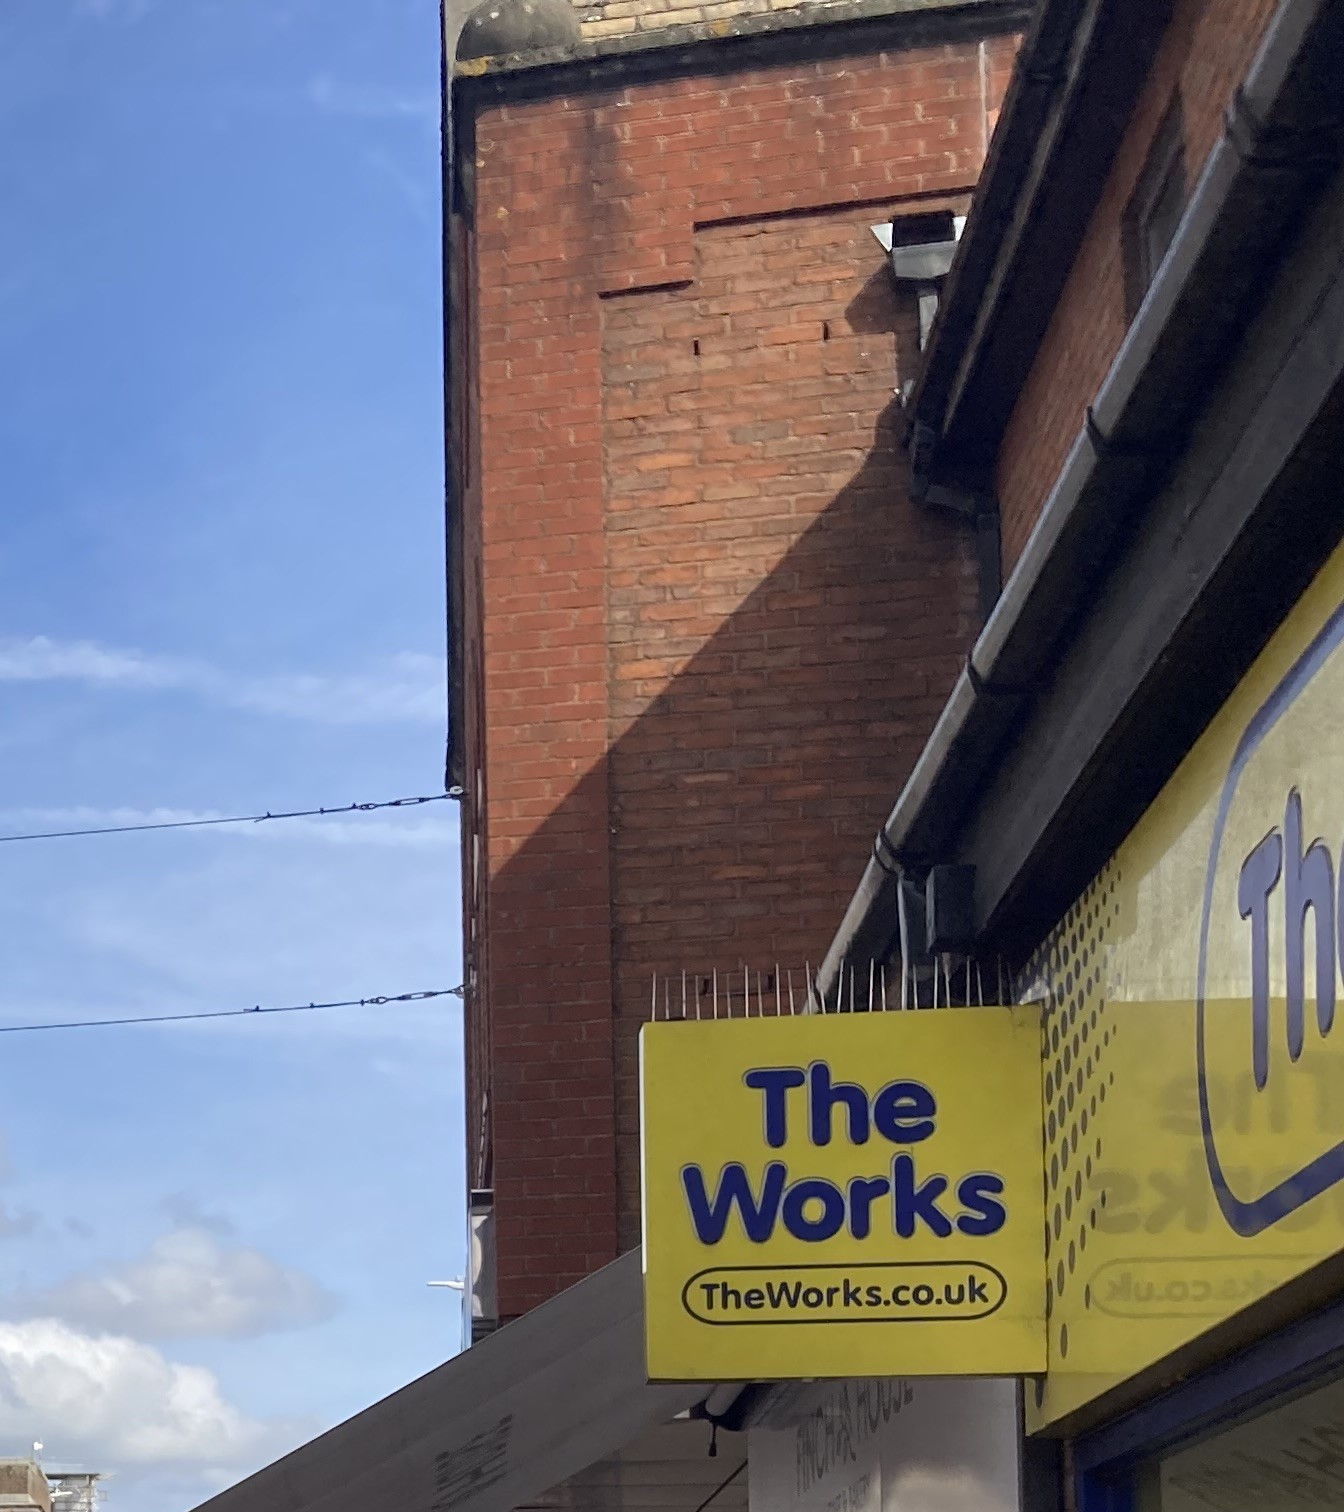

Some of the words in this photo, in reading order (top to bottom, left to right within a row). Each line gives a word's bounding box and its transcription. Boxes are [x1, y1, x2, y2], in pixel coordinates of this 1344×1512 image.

[1238, 785, 1344, 1092] Th
[744, 1060, 937, 1148] The
[679, 1151, 1007, 1246] Works
[700, 1275, 989, 1310] TheWorks.co.uk
